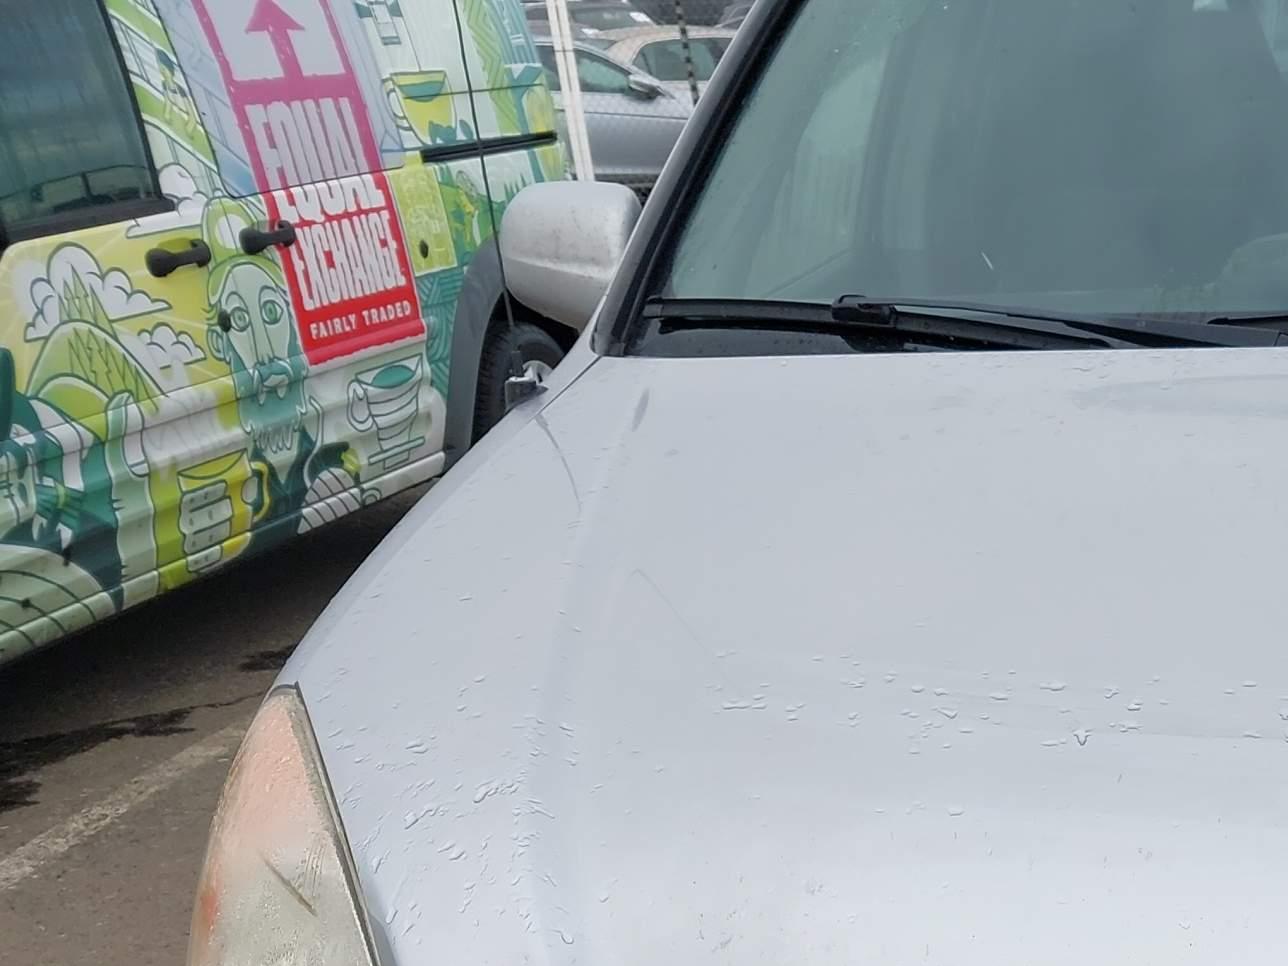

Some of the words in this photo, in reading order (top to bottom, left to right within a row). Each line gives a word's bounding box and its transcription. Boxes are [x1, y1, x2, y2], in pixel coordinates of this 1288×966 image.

[244, 97, 385, 223] EQUAL
[289, 210, 407, 311] EXCHANGE
[309, 313, 358, 340] FAIRLY
[363, 301, 412, 325] TRADED
